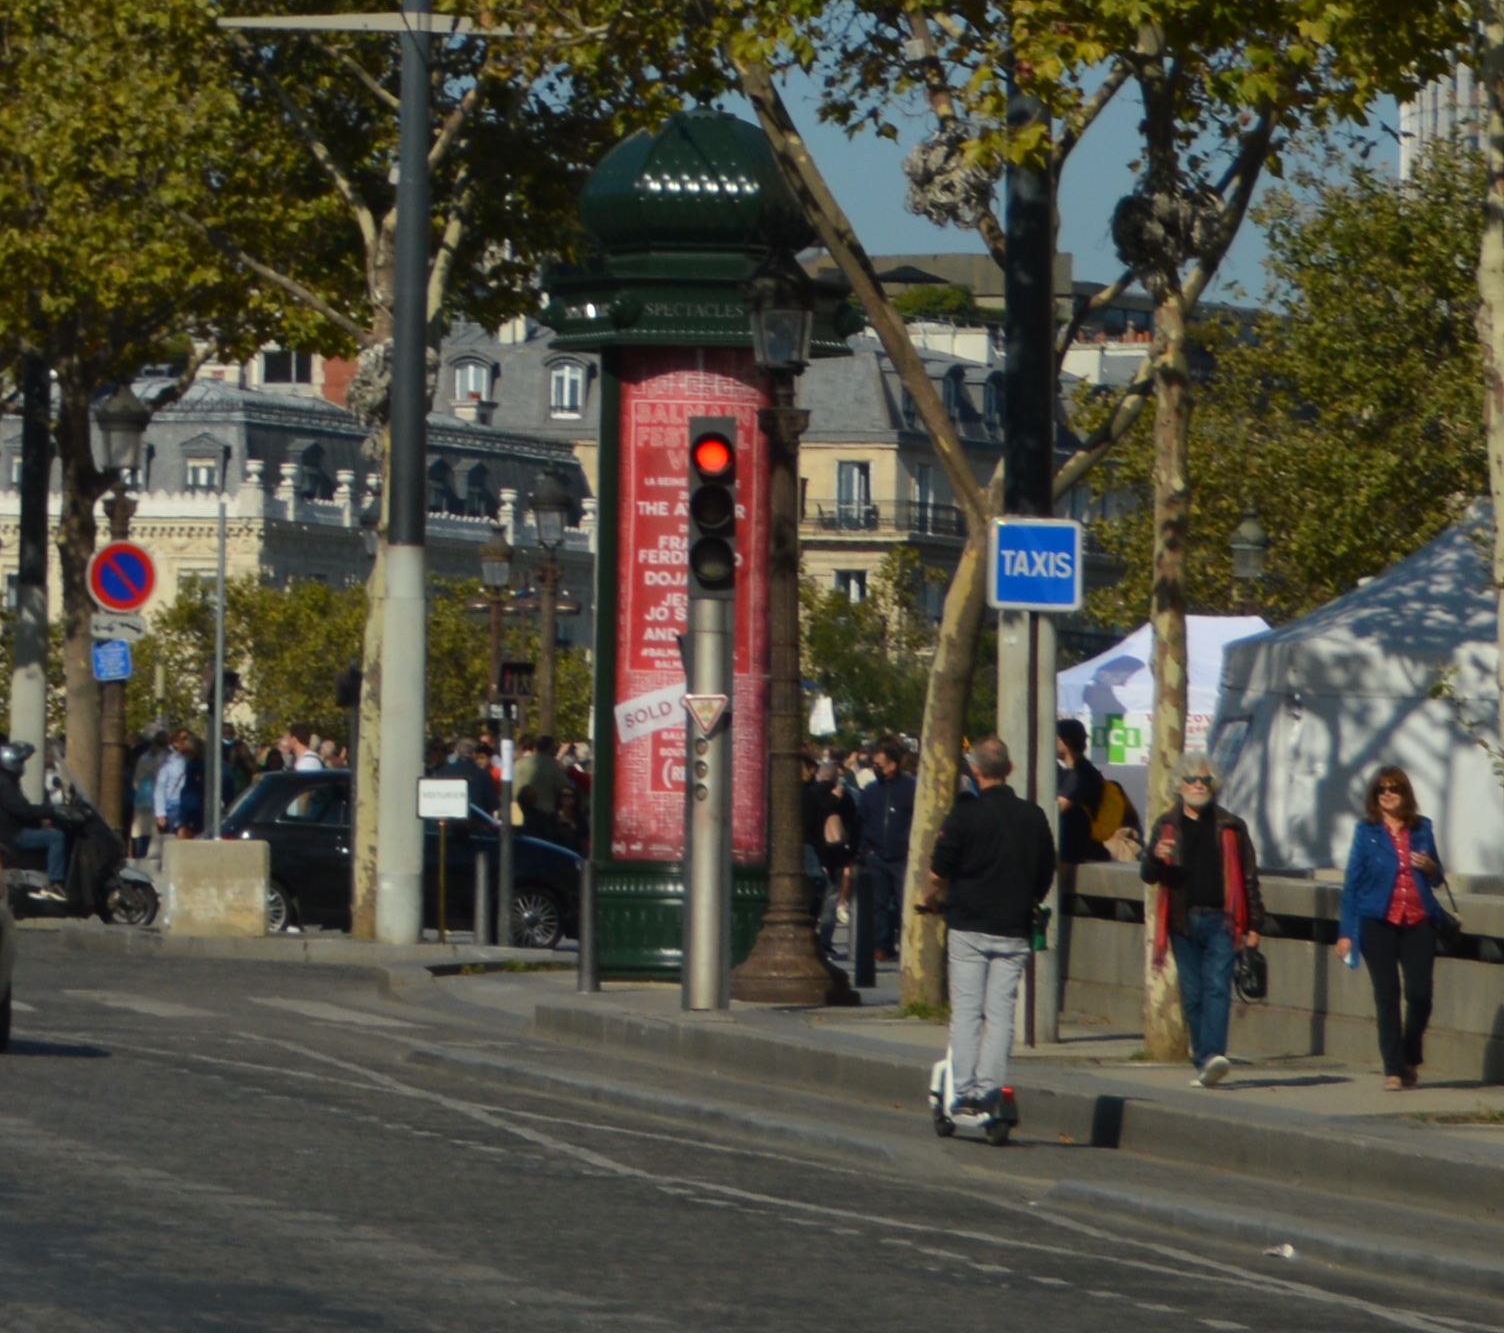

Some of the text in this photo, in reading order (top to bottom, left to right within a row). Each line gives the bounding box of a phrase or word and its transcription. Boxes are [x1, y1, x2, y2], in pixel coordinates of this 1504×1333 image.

[645, 302, 745, 318] SPECTACLES
[636, 403, 752, 427] BALMAIN
[637, 501, 669, 516] THE
[1000, 549, 1073, 579] TAXIS
[644, 607, 669, 621] JO
[643, 627, 681, 641] AND
[624, 700, 672, 728] SOLD
[1096, 728, 1136, 746] ICI
